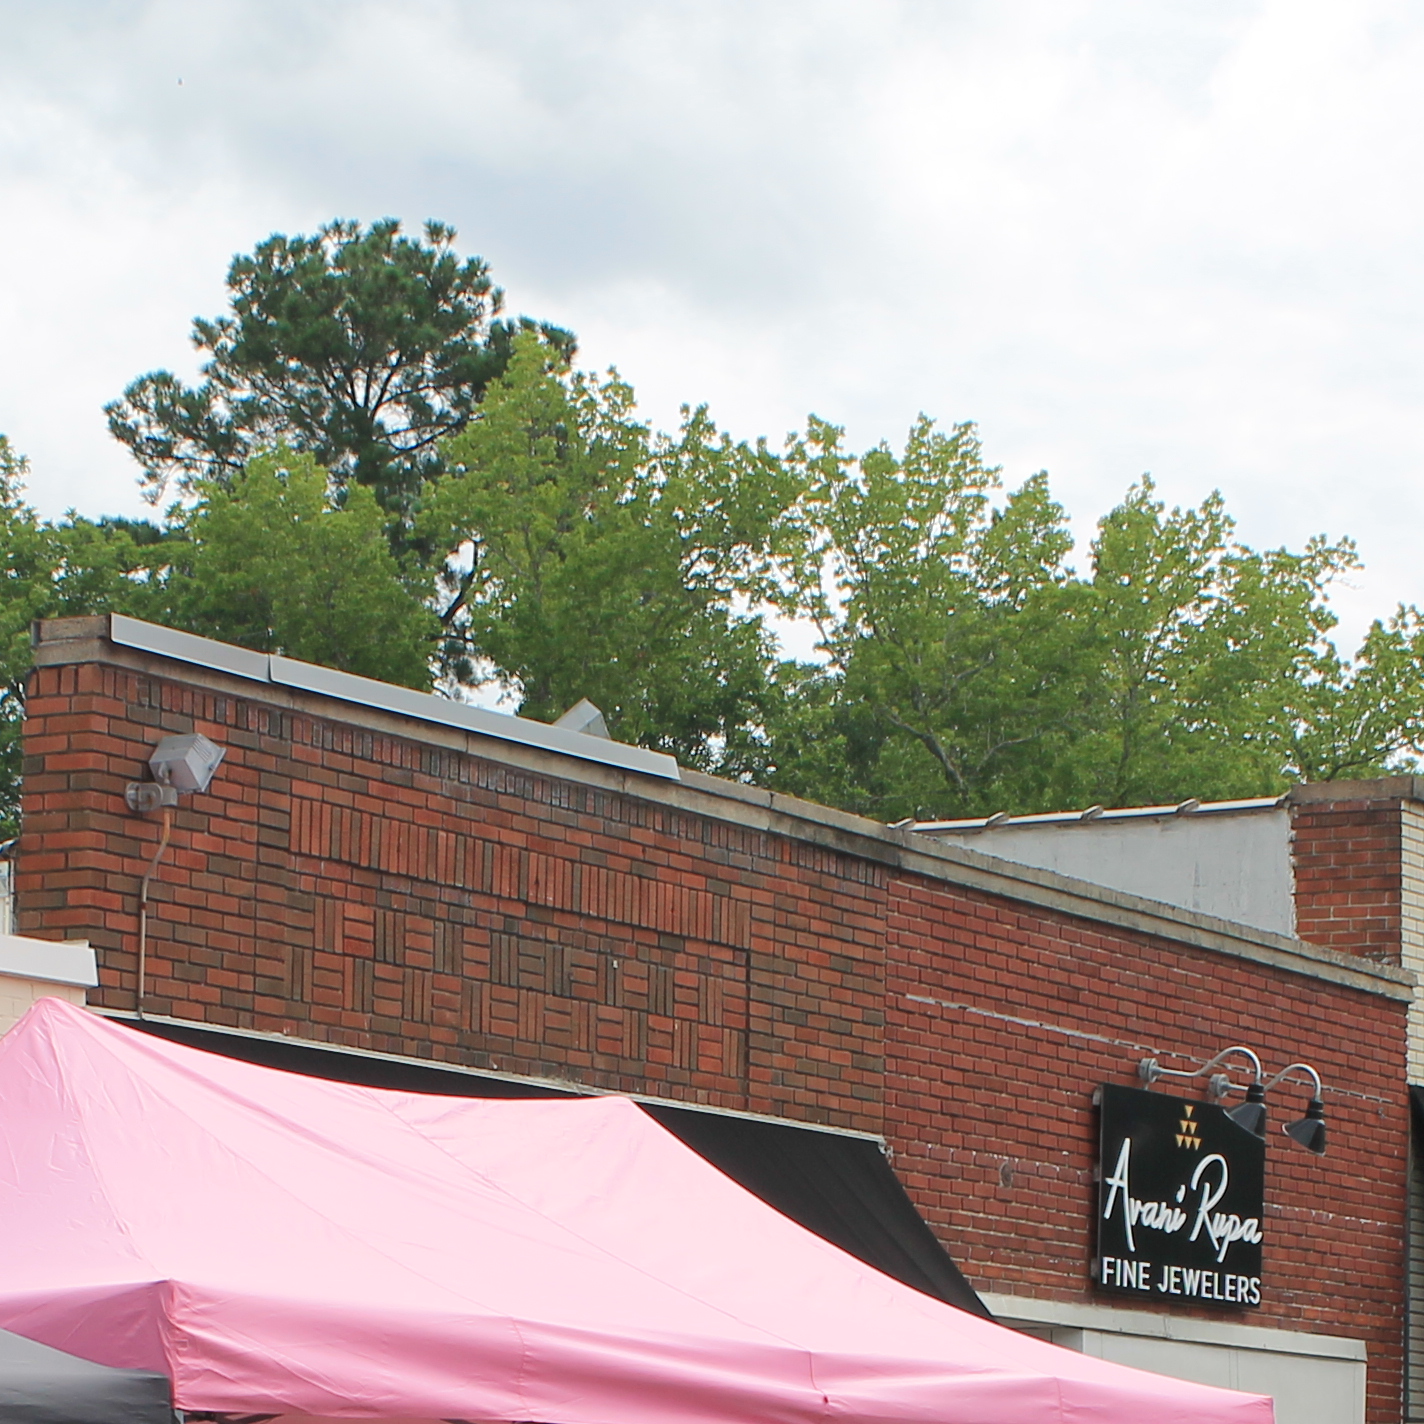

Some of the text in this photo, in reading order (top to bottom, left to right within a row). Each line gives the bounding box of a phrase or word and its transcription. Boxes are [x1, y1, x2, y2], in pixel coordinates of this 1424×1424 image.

[1104, 1137, 1264, 1263] Avani Rupa
[1101, 1256, 1261, 1304] FINE JEWELERS
